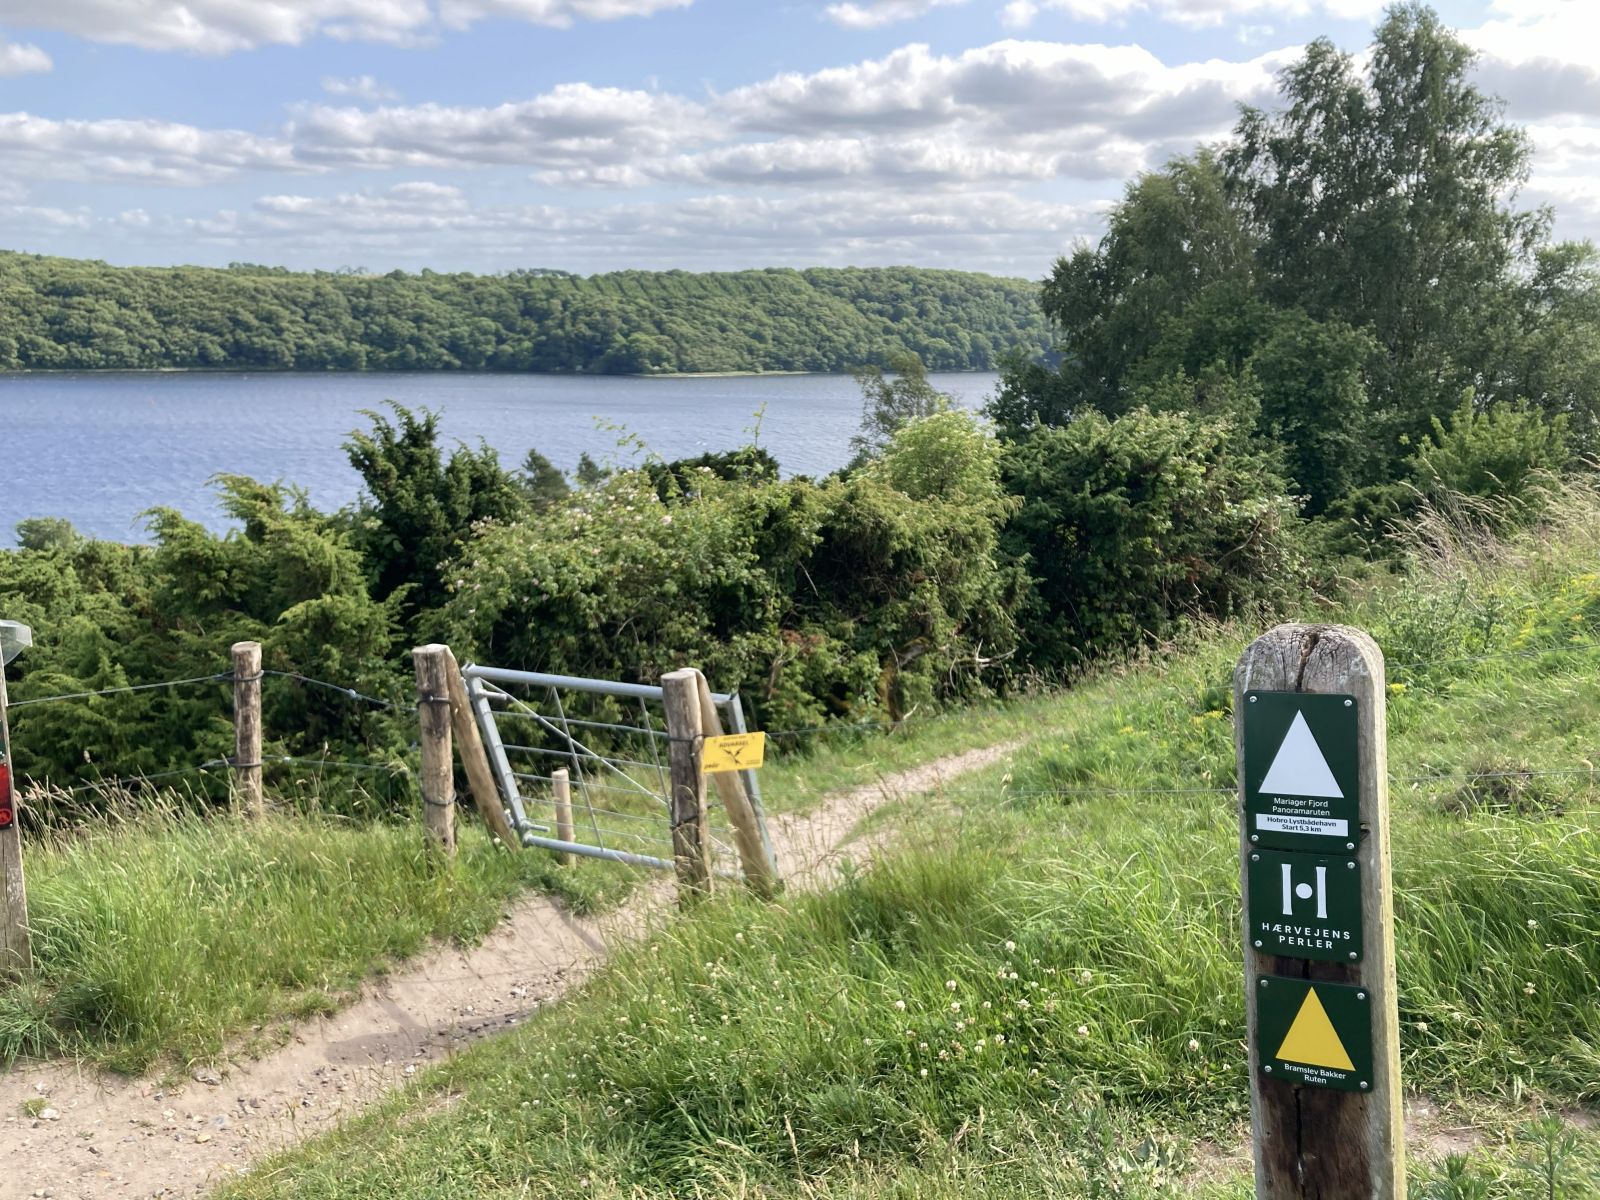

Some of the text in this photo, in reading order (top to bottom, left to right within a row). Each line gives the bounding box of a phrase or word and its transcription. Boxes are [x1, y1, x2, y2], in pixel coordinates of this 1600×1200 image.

[1274, 797, 1329, 808] Mariager Fjord
[1272, 806, 1330, 816] Panoramaruten
[1267, 816, 1336, 827] Hobro Lystbådehavn
[1262, 922, 1350, 940] HÆRVEJENS
[1279, 935, 1333, 949] PERLER
[1284, 1063, 1346, 1080] Bramslev Bakker
[1304, 1074, 1327, 1084] Ruten
